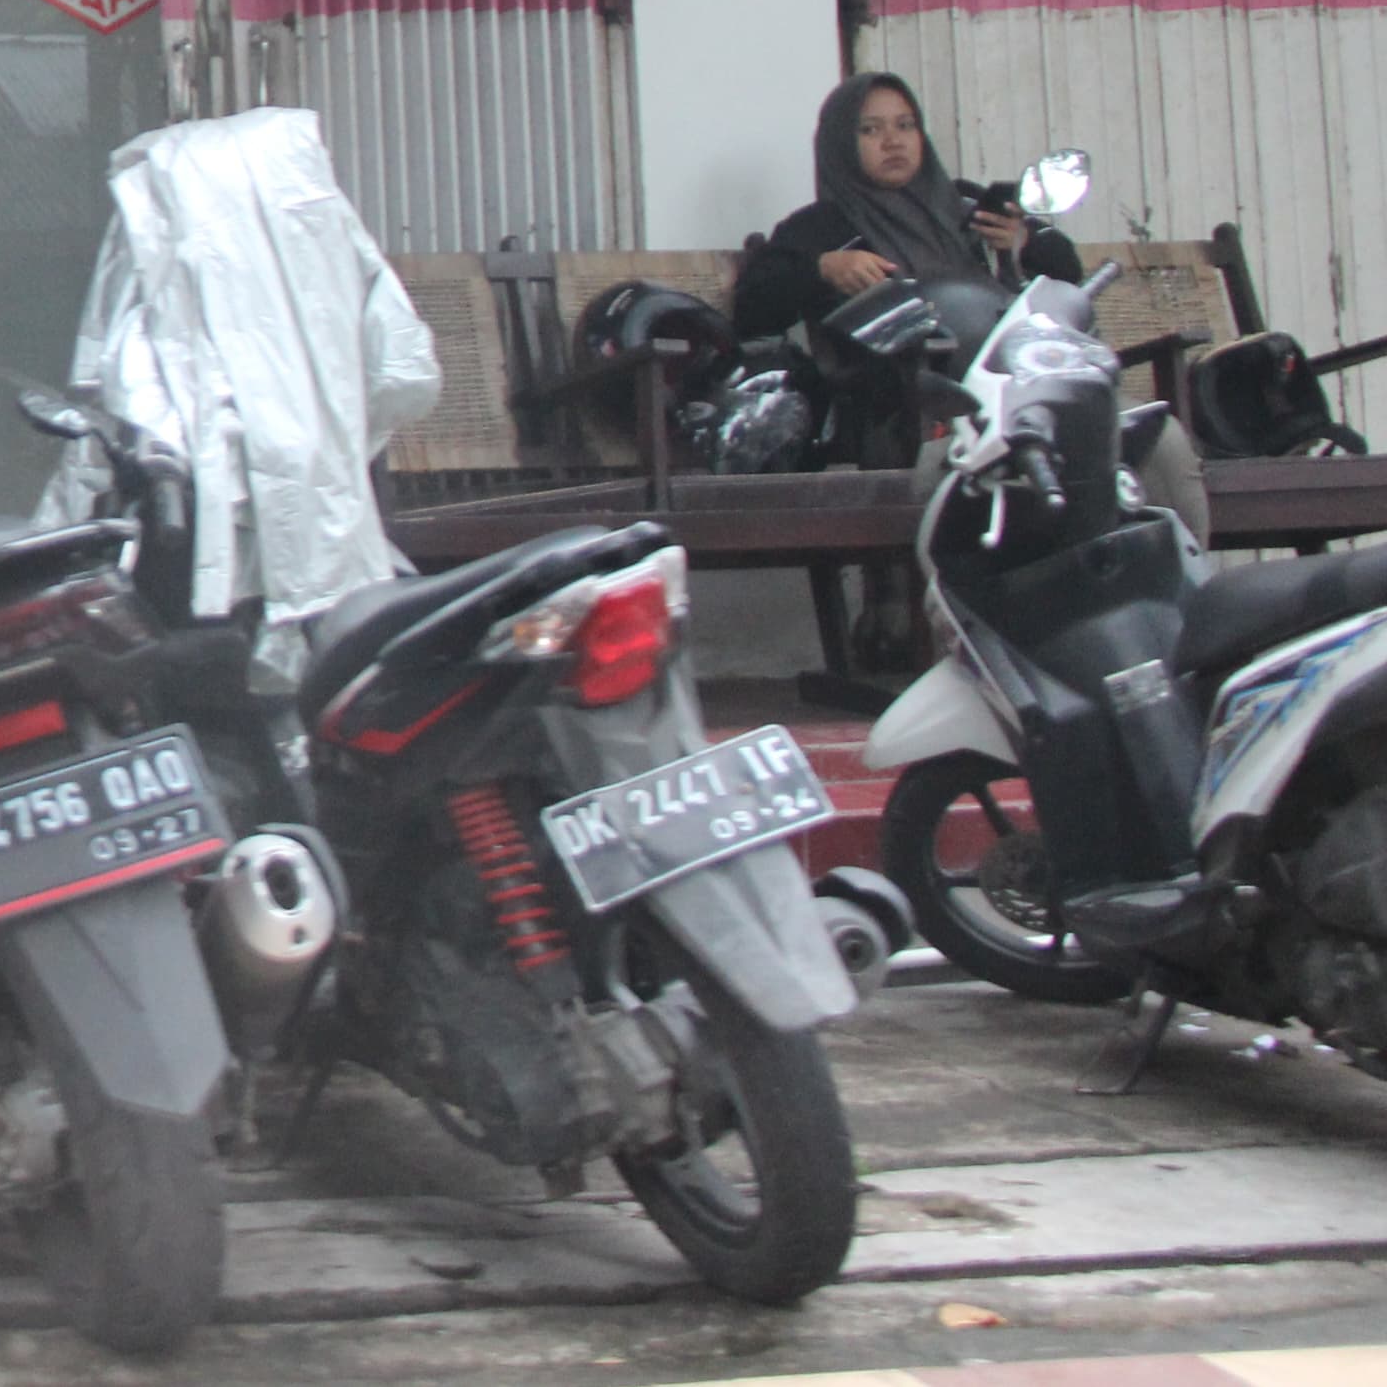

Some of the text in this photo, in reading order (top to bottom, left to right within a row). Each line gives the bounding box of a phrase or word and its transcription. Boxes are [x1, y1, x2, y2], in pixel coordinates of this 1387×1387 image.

[551, 735, 792, 856] DK 2447 IF
